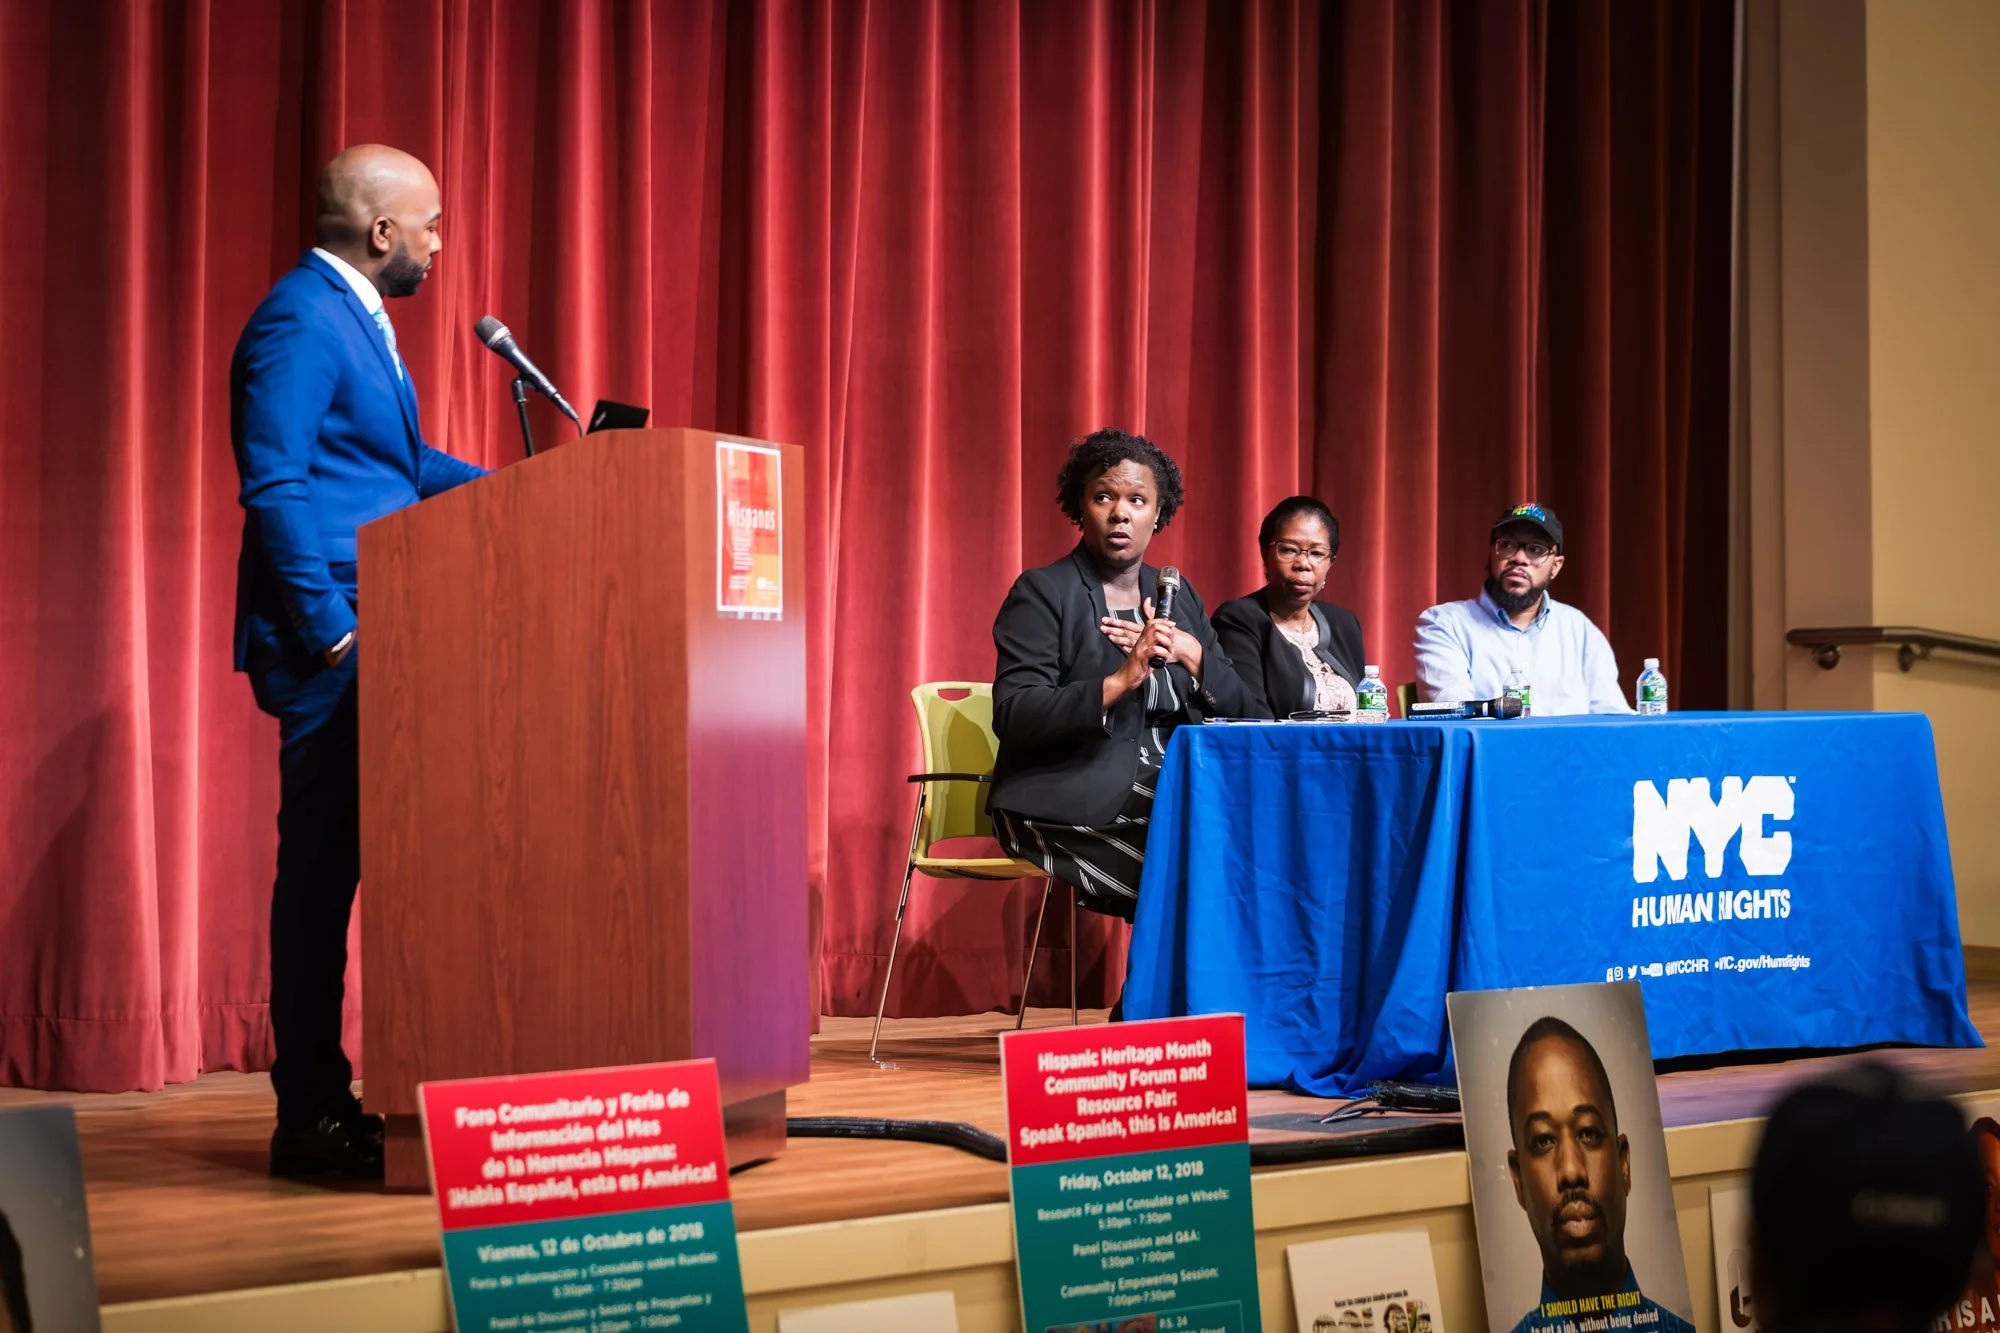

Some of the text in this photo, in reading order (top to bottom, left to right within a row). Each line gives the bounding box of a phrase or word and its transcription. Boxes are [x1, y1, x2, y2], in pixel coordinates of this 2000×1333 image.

[728, 500, 776, 535] Hispanos
[1632, 775, 1795, 884] NYC
[1632, 888, 1791, 928] HUMAN RIGHTS
[1037, 1038, 1212, 1073] Hispanic Heritage Month
[1044, 1061, 1207, 1095] Community Forum and
[455, 1087, 690, 1128] Foro Comunitario y Feria de
[1076, 1088, 1177, 1116] Resource Fair:
[491, 1117, 661, 1152] Información del Mes
[1020, 1106, 1237, 1149] Speak Spanish, this is America!
[482, 1143, 678, 1179] de la Herencia Hispana:
[1059, 1160, 1204, 1192] Friday, October 12, 2018
[505, 1176, 579, 1206] Español,
[580, 1173, 617, 1196] esta
[619, 1173, 639, 1192] es
[642, 1161, 718, 1189] América!
[1037, 1186, 1230, 1222] Resource Fair and Consulate on Wheels:
[477, 1221, 704, 1263] Viernes, 12 de Octubre de 2018
[1073, 1228, 1201, 1256] Panel Discussion and Q&A:
[1060, 1267, 1219, 1299] Community Empowering Session:
[1541, 1290, 1641, 1319] I SHOULD HAVE THE RIGHT
[1579, 1316, 1609, 1333] without
[1609, 1312, 1632, 1329] being
[1633, 1307, 1660, 1325] denied
[1955, 1299, 1976, 1329] IS
[1981, 1296, 1996, 1325] A
